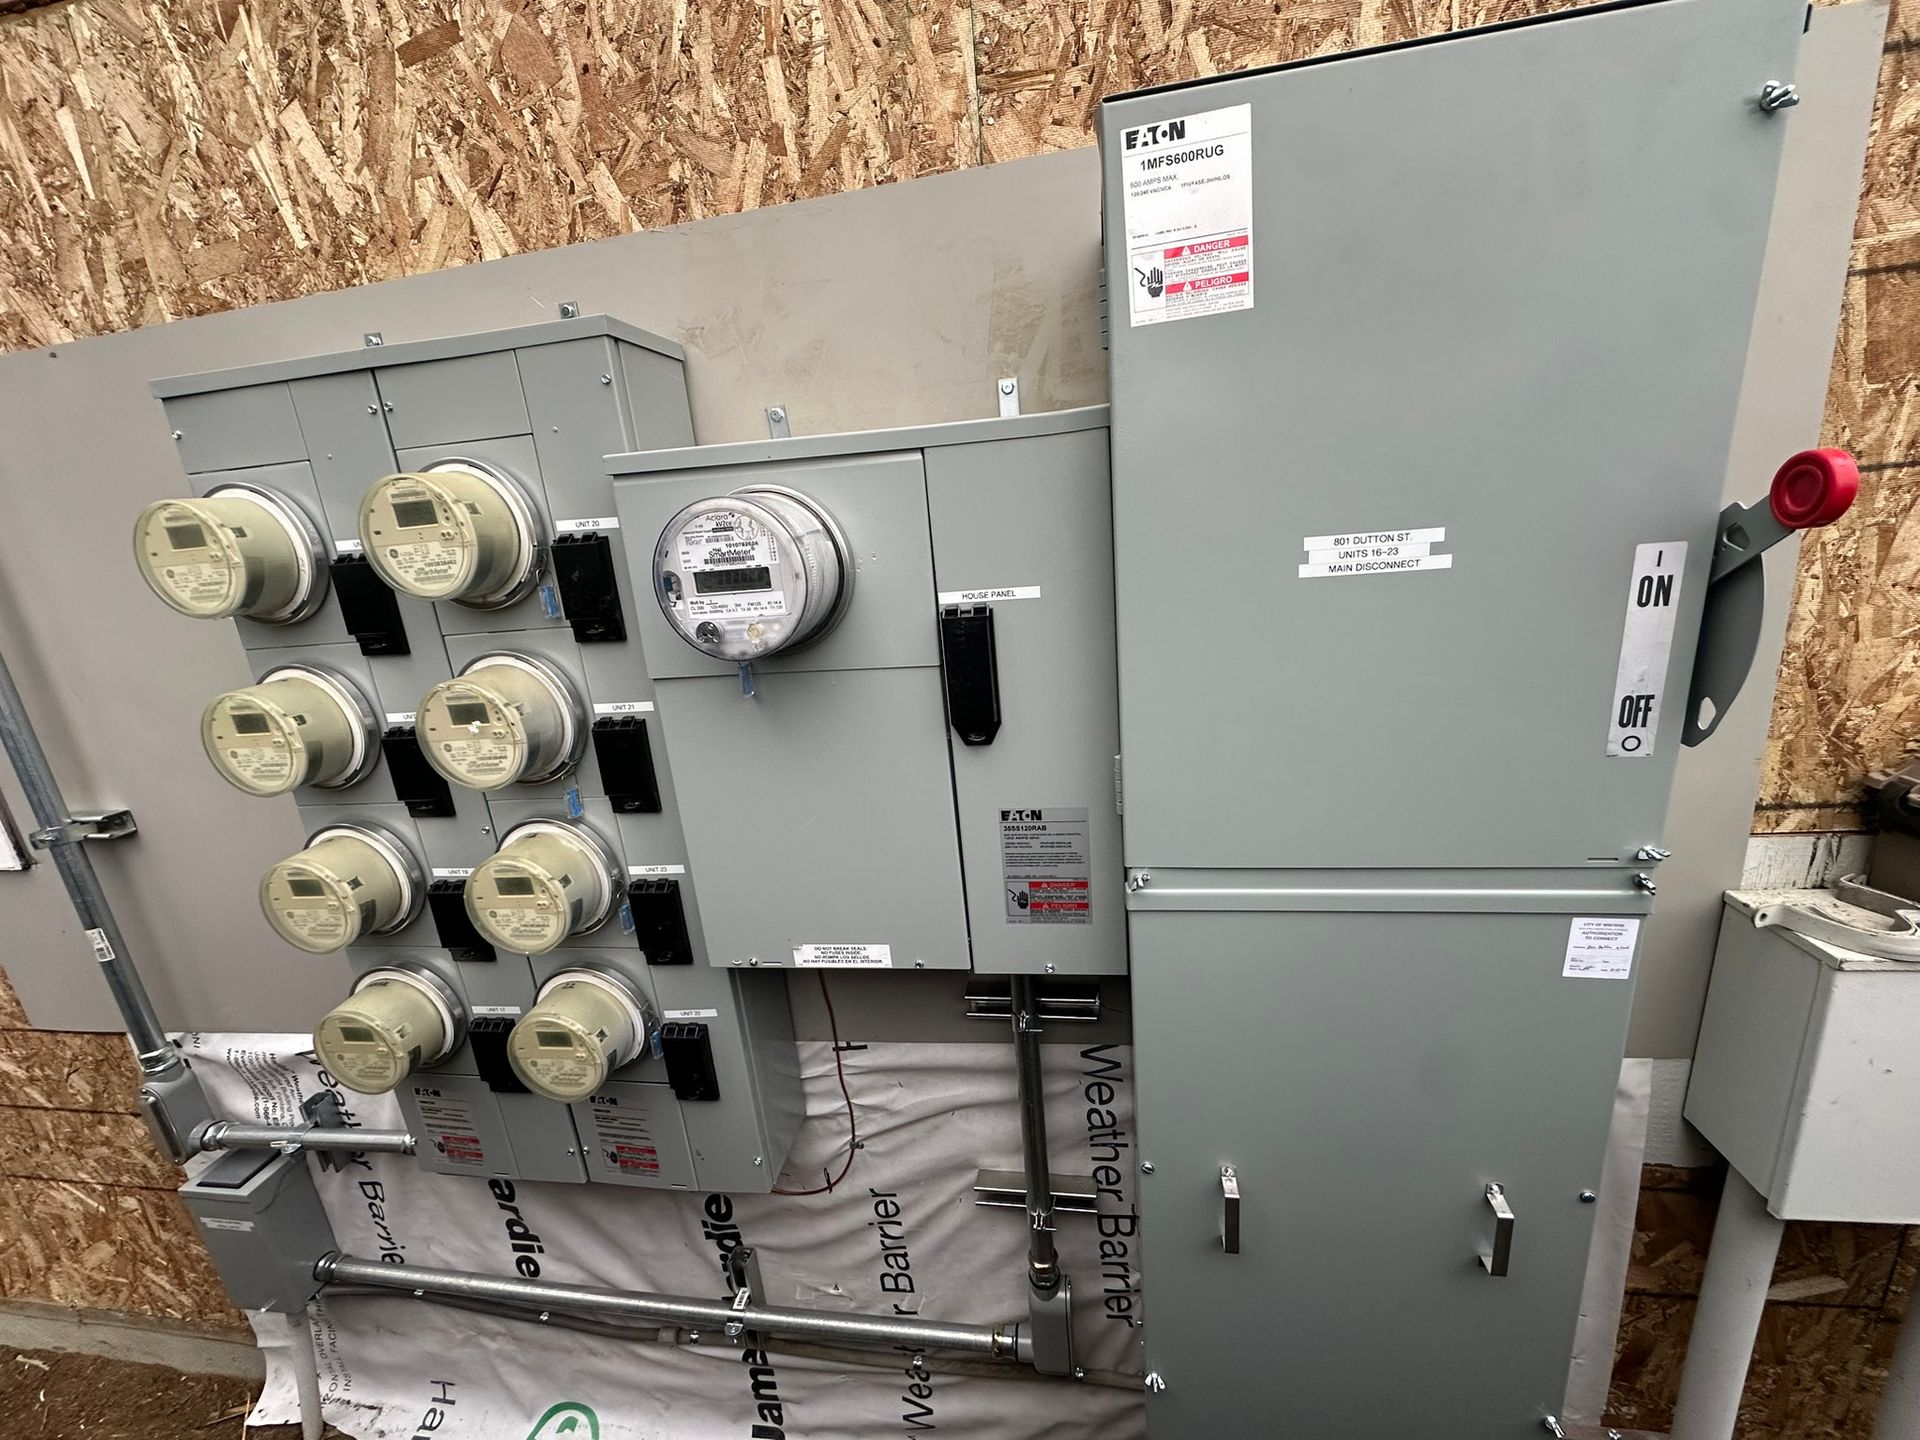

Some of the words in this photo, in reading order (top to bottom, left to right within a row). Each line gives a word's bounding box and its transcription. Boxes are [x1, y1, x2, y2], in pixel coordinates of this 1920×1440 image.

[1125, 120, 1185, 150] EATON
[1140, 145, 1224, 171] 1MFS600RUG
[1142, 177, 1161, 186] AMPS
[1194, 240, 1230, 252] DANGER
[1195, 276, 1232, 288] PELIGRO
[1334, 538, 1350, 546] 801
[1353, 534, 1394, 544] DUTTON
[1397, 533, 1413, 542] ST.
[1338, 550, 1368, 559] UNITS
[1372, 547, 1398, 557] 16-23
[1329, 565, 1352, 573] MAIN
[1356, 559, 1421, 571] DISCONNECT
[1637, 575, 1673, 607] ON
[1619, 695, 1655, 728] OFF
[1001, 810, 1042, 821] EATON
[1079, 1044, 1129, 1203] Weather
[359, 1180, 405, 1265] Barrie
[488, 1178, 545, 1279] ardie
[868, 1187, 916, 1294] Barrier
[1096, 1213, 1141, 1329] Barrier
[741, 1349, 786, 1440] Jame
